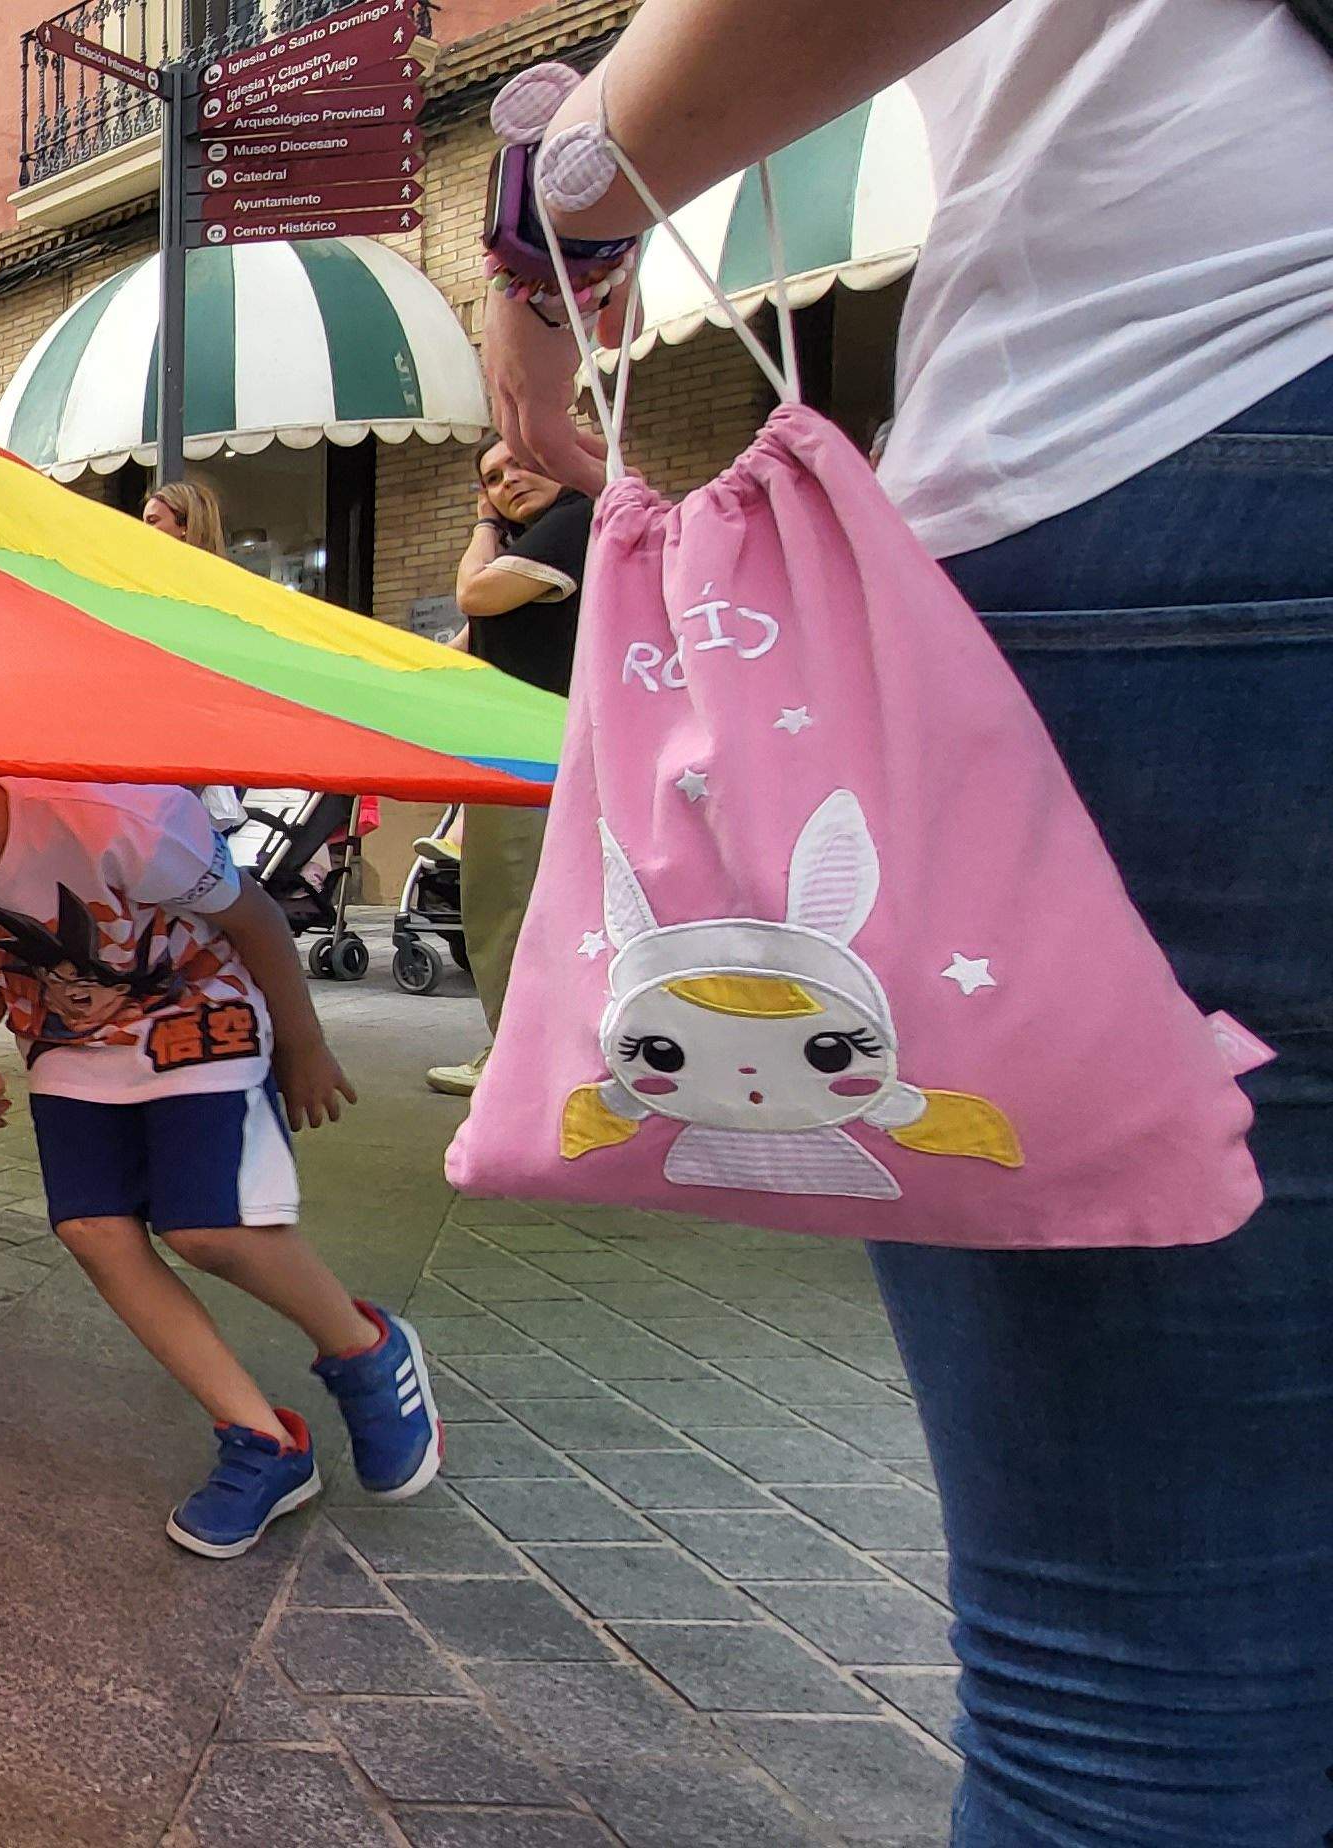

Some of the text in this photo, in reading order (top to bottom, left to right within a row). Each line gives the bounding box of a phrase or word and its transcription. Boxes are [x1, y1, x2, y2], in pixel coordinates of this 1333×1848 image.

[228, 4, 389, 74] Iglesia de Santo Domingo
[74, 41, 146, 82] Estación Intermodal
[226, 100, 242, 114] de
[244, 92, 268, 106] San
[271, 75, 309, 97] Pedro
[311, 69, 323, 81] el
[326, 55, 358, 76] Viejo
[227, 52, 331, 101] Iglesia y Claustro
[234, 105, 385, 130] Arqueológico Provincial
[233, 138, 348, 156] Museo Diocesano
[233, 169, 287, 183] Catedral
[233, 194, 321, 212] Ayuntamiento
[233, 220, 336, 238] Centro Histórico
